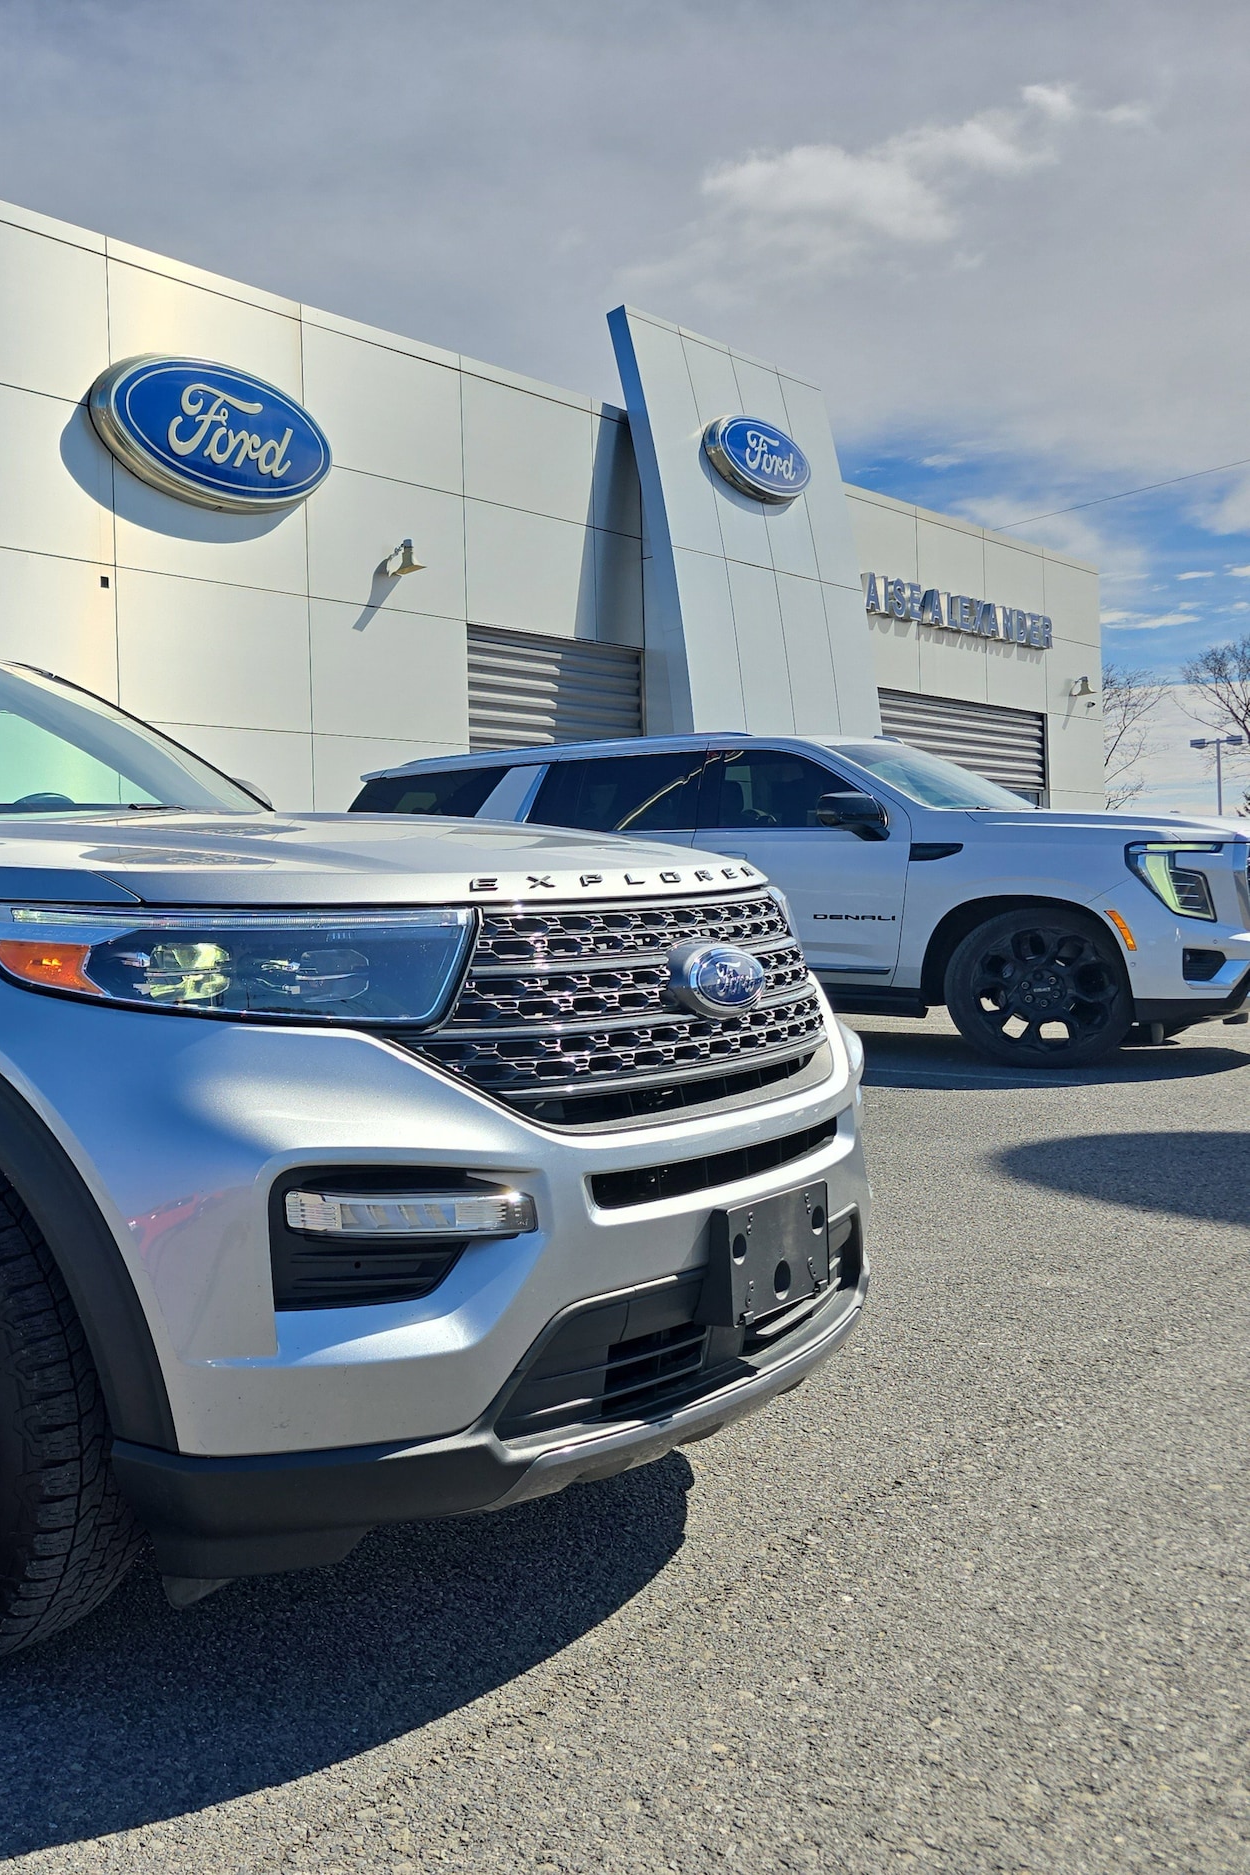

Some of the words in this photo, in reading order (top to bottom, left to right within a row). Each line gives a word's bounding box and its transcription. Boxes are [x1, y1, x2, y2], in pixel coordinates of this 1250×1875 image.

[167, 383, 293, 478] Ford
[745, 430, 796, 480] Ford
[921, 589, 1052, 649] ALEXANDER
[469, 865, 755, 892] EXPLORER
[716, 962, 754, 996] Ford
